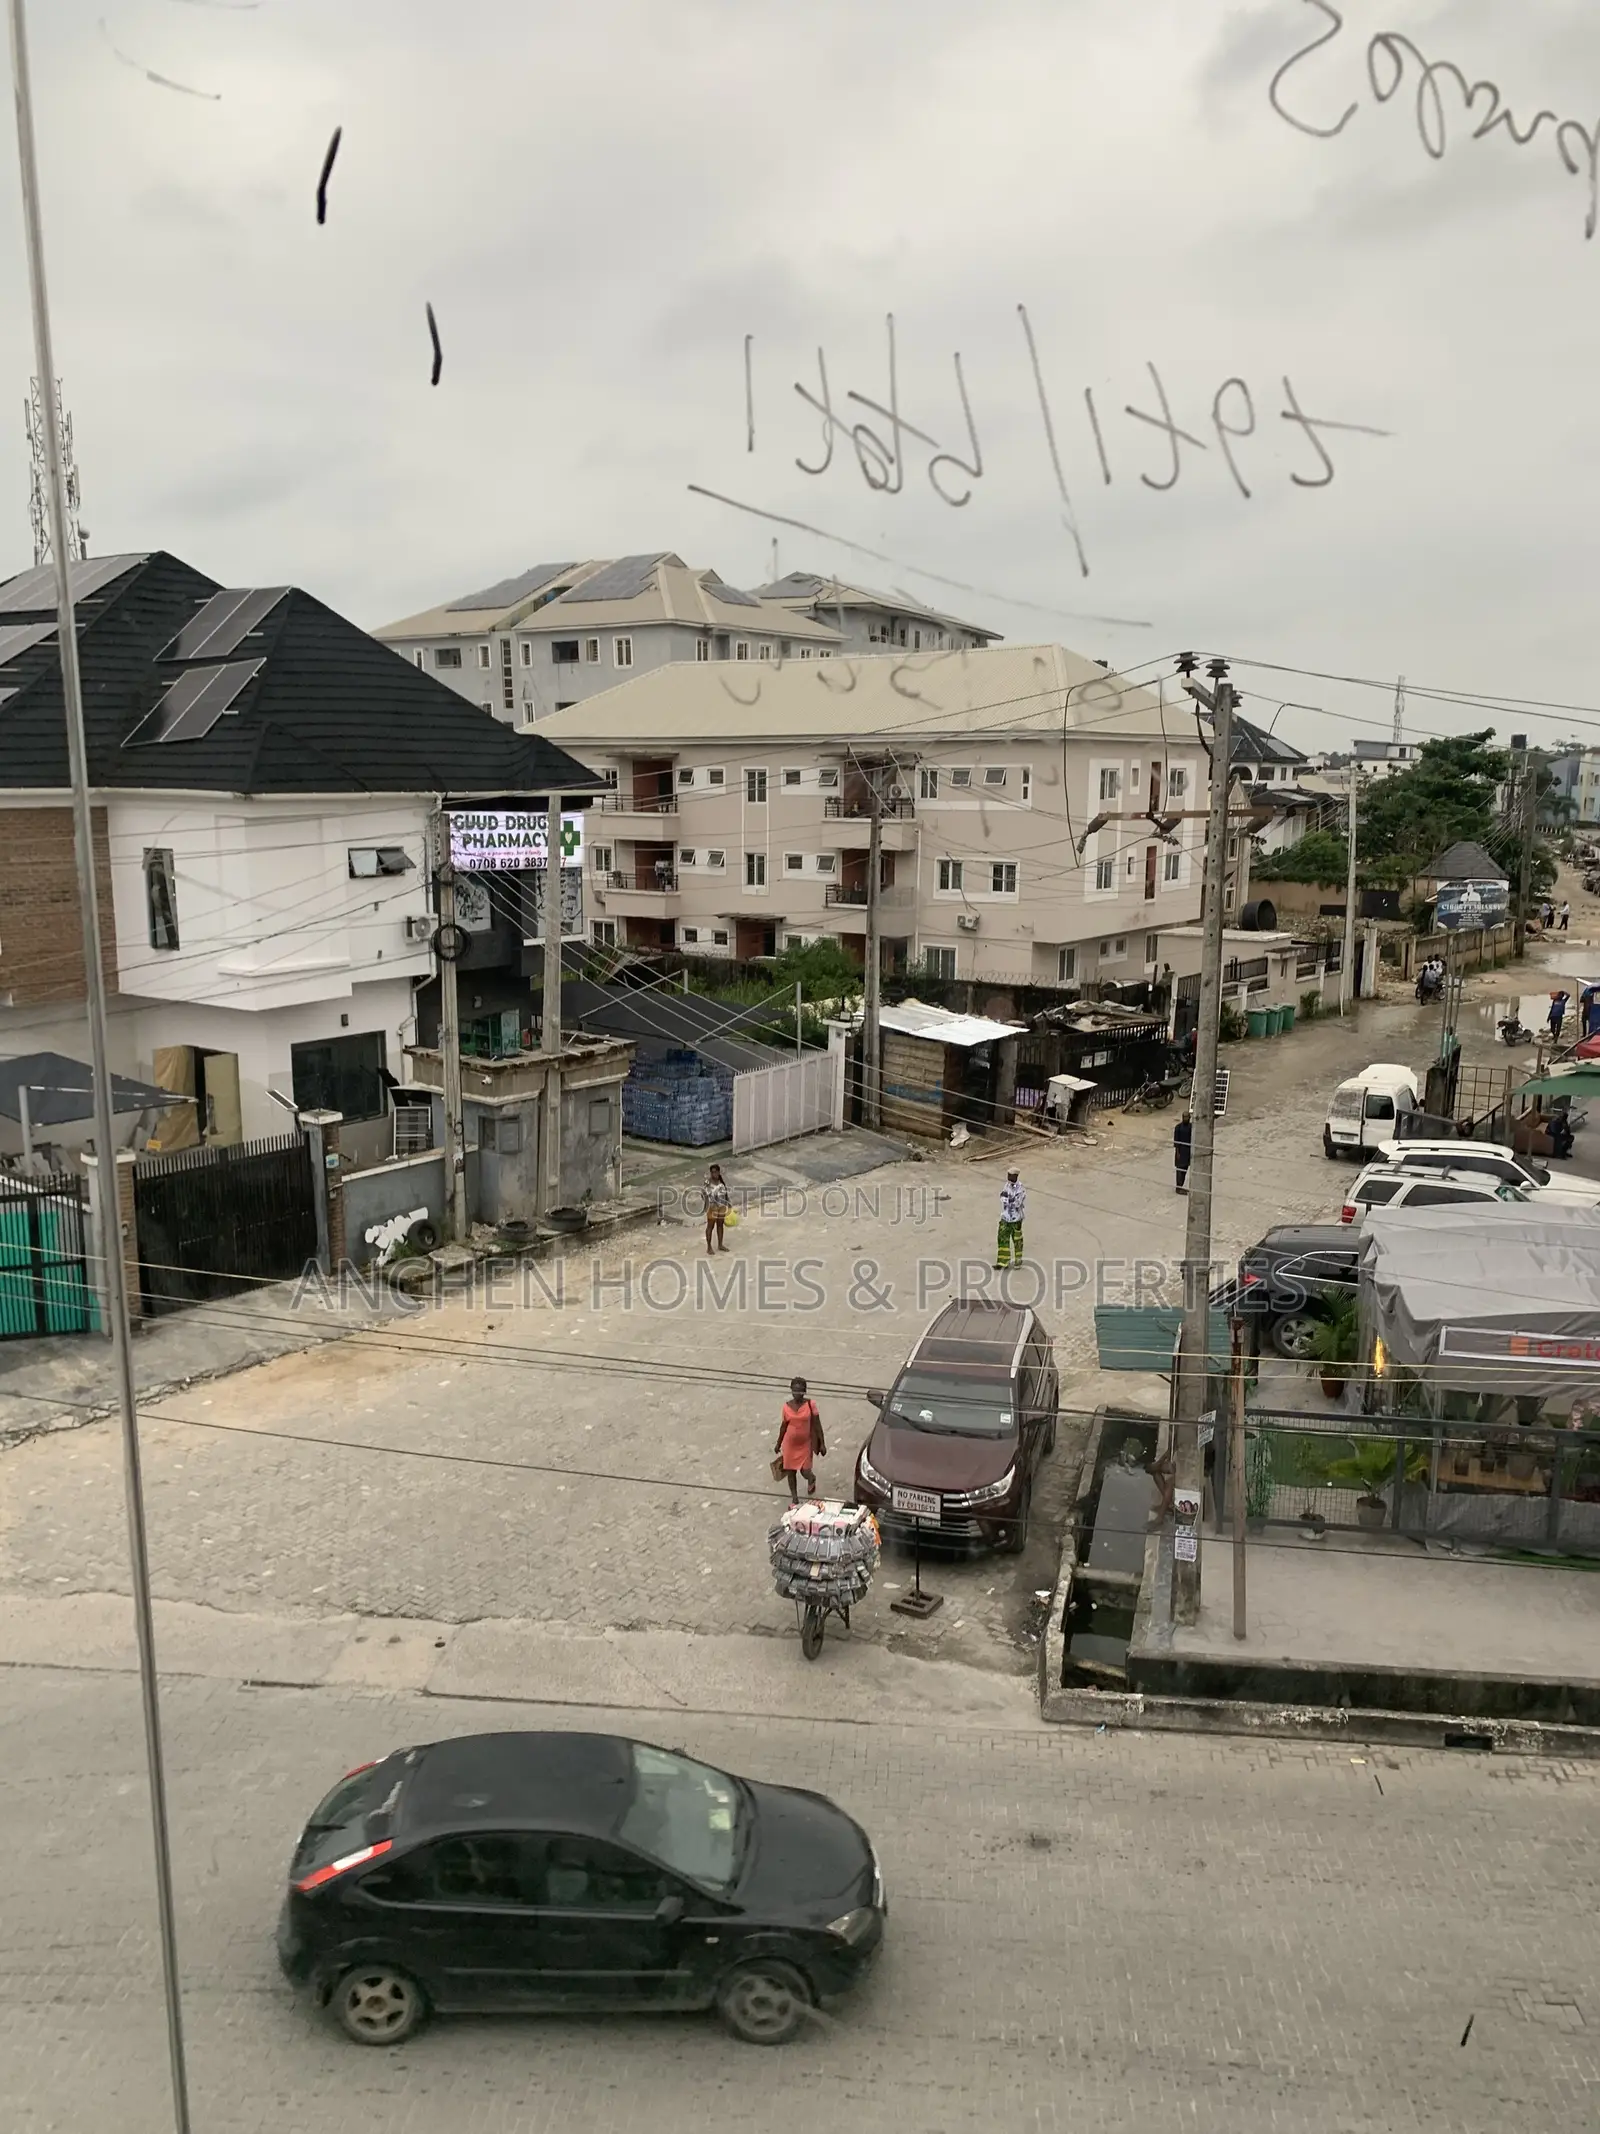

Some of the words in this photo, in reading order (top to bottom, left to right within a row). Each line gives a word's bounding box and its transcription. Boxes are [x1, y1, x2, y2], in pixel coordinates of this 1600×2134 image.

[505, 815, 548, 831] DRUG
[469, 859, 497, 870] 0708
[500, 858, 520, 869] 620
[524, 857, 548, 868] 3837
[897, 1490, 908, 1499] NO
[910, 1492, 936, 1504] PARKING
